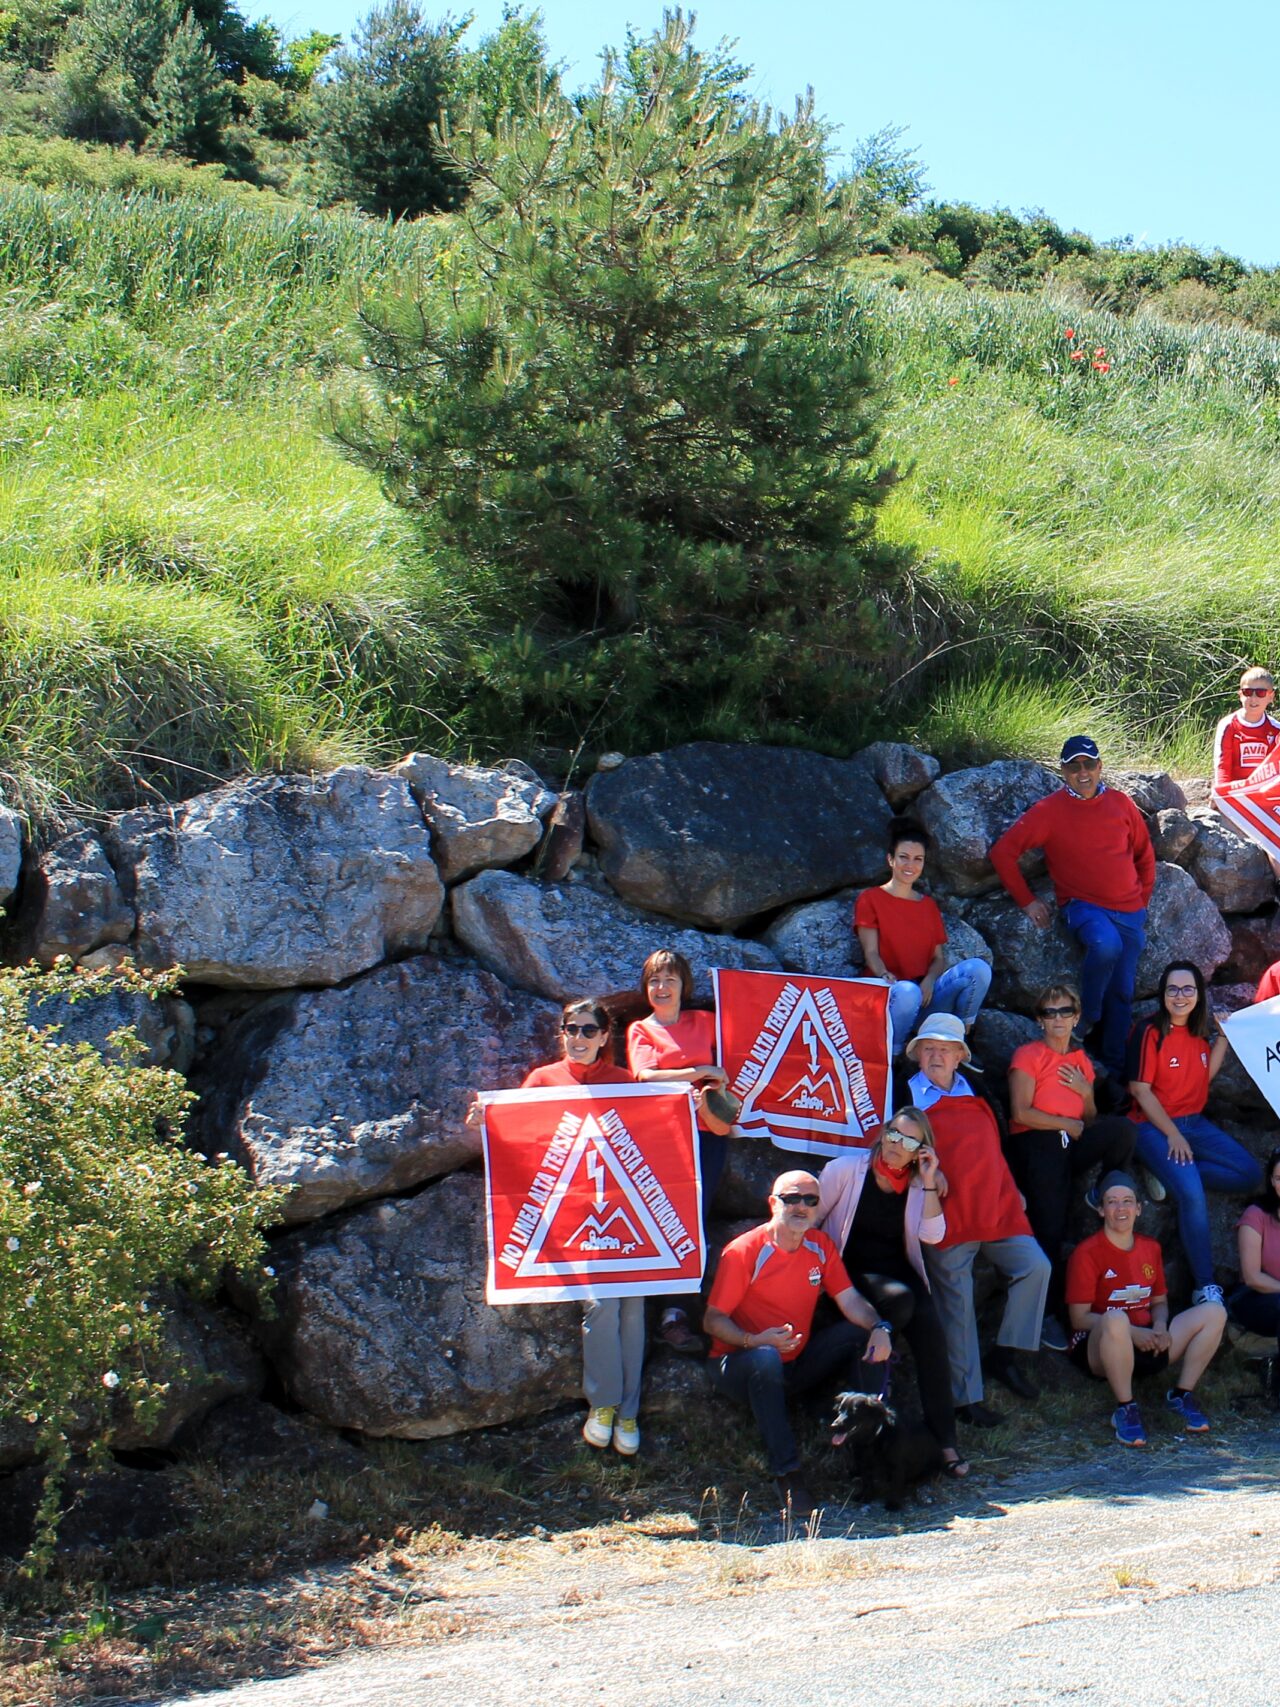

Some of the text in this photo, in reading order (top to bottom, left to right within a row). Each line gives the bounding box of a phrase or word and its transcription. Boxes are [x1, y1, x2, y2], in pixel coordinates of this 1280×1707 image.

[731, 982, 801, 1096] LINEA ALTA TENSION
[814, 988, 849, 1047] AUTOPISTA
[861, 1113, 881, 1131] EZ
[498, 1111, 582, 1270] NO LINEA ALTA TENSION
[597, 1108, 696, 1260] AUTOPISTA ELEKTRIKORIK EZ
